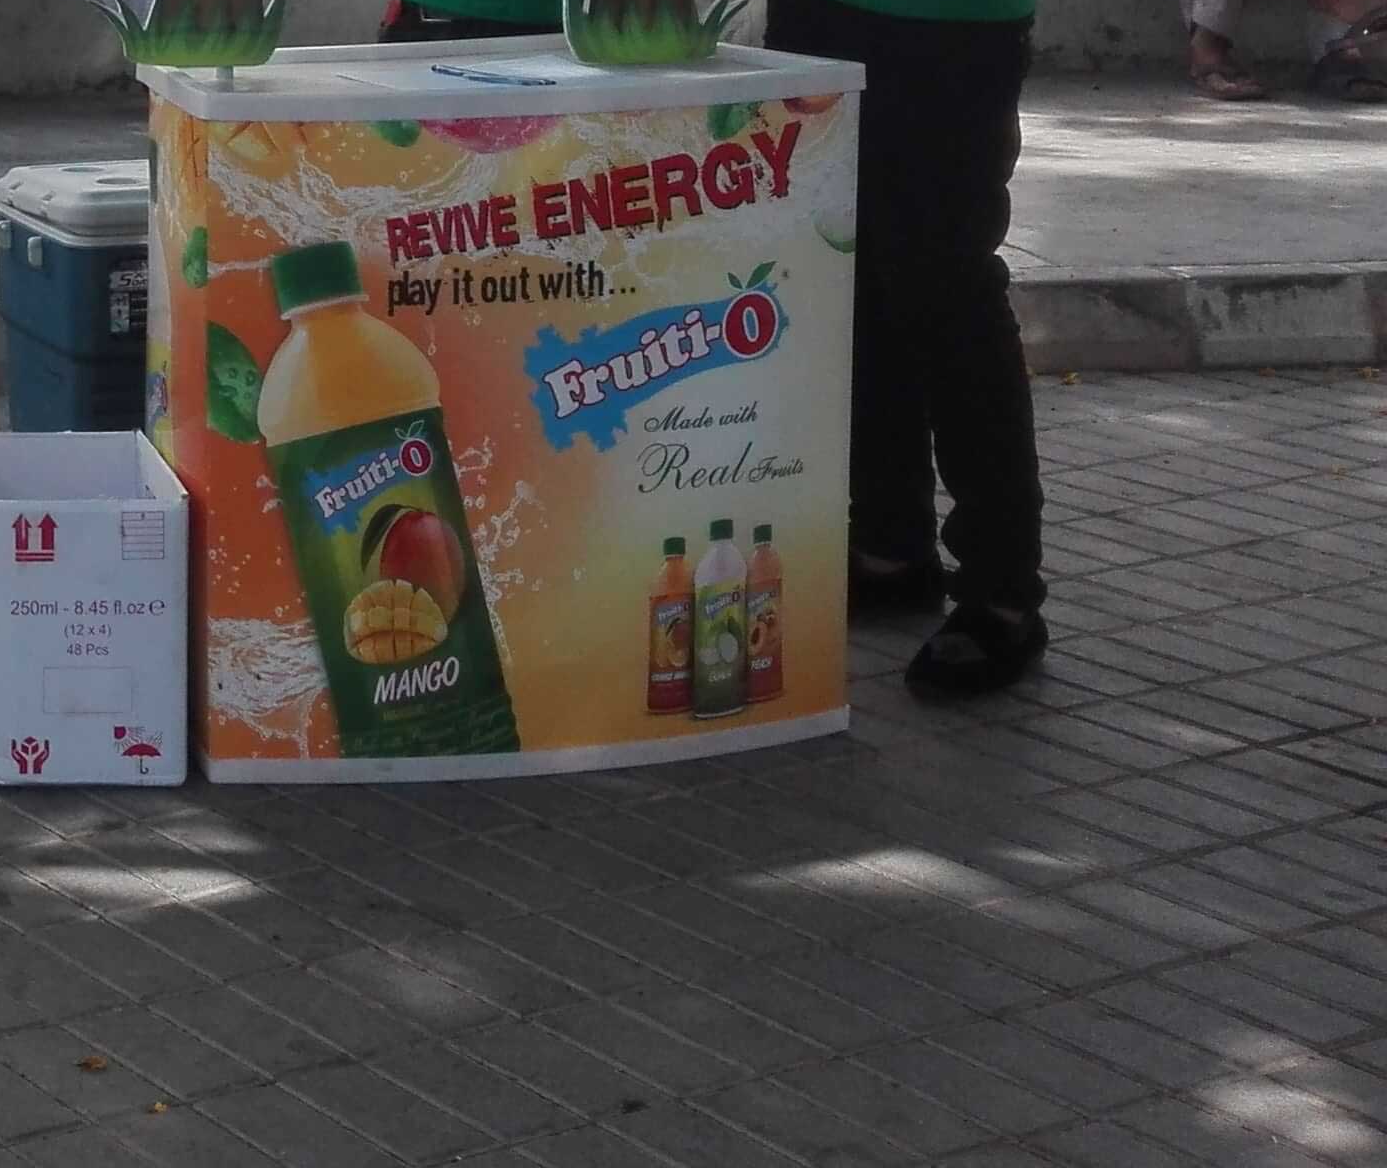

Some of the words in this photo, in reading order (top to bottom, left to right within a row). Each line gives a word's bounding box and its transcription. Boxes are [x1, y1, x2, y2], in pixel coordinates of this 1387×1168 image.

[386, 194, 521, 262] REVIVE
[532, 120, 802, 240] ENERGY
[387, 272, 444, 317] play
[452, 271, 475, 306] it
[481, 270, 531, 304] out
[541, 290, 780, 419] Fruiti-O
[644, 406, 714, 434] Made
[718, 399, 759, 427] with
[314, 437, 434, 519] Fruiti-O
[638, 440, 753, 494] Real
[749, 459, 805, 483] Fruits
[10, 600, 58, 616] 250ml
[74, 600, 109, 616] 8.45
[86, 643, 109, 656] Pcs
[374, 656, 460, 705] MANGO
